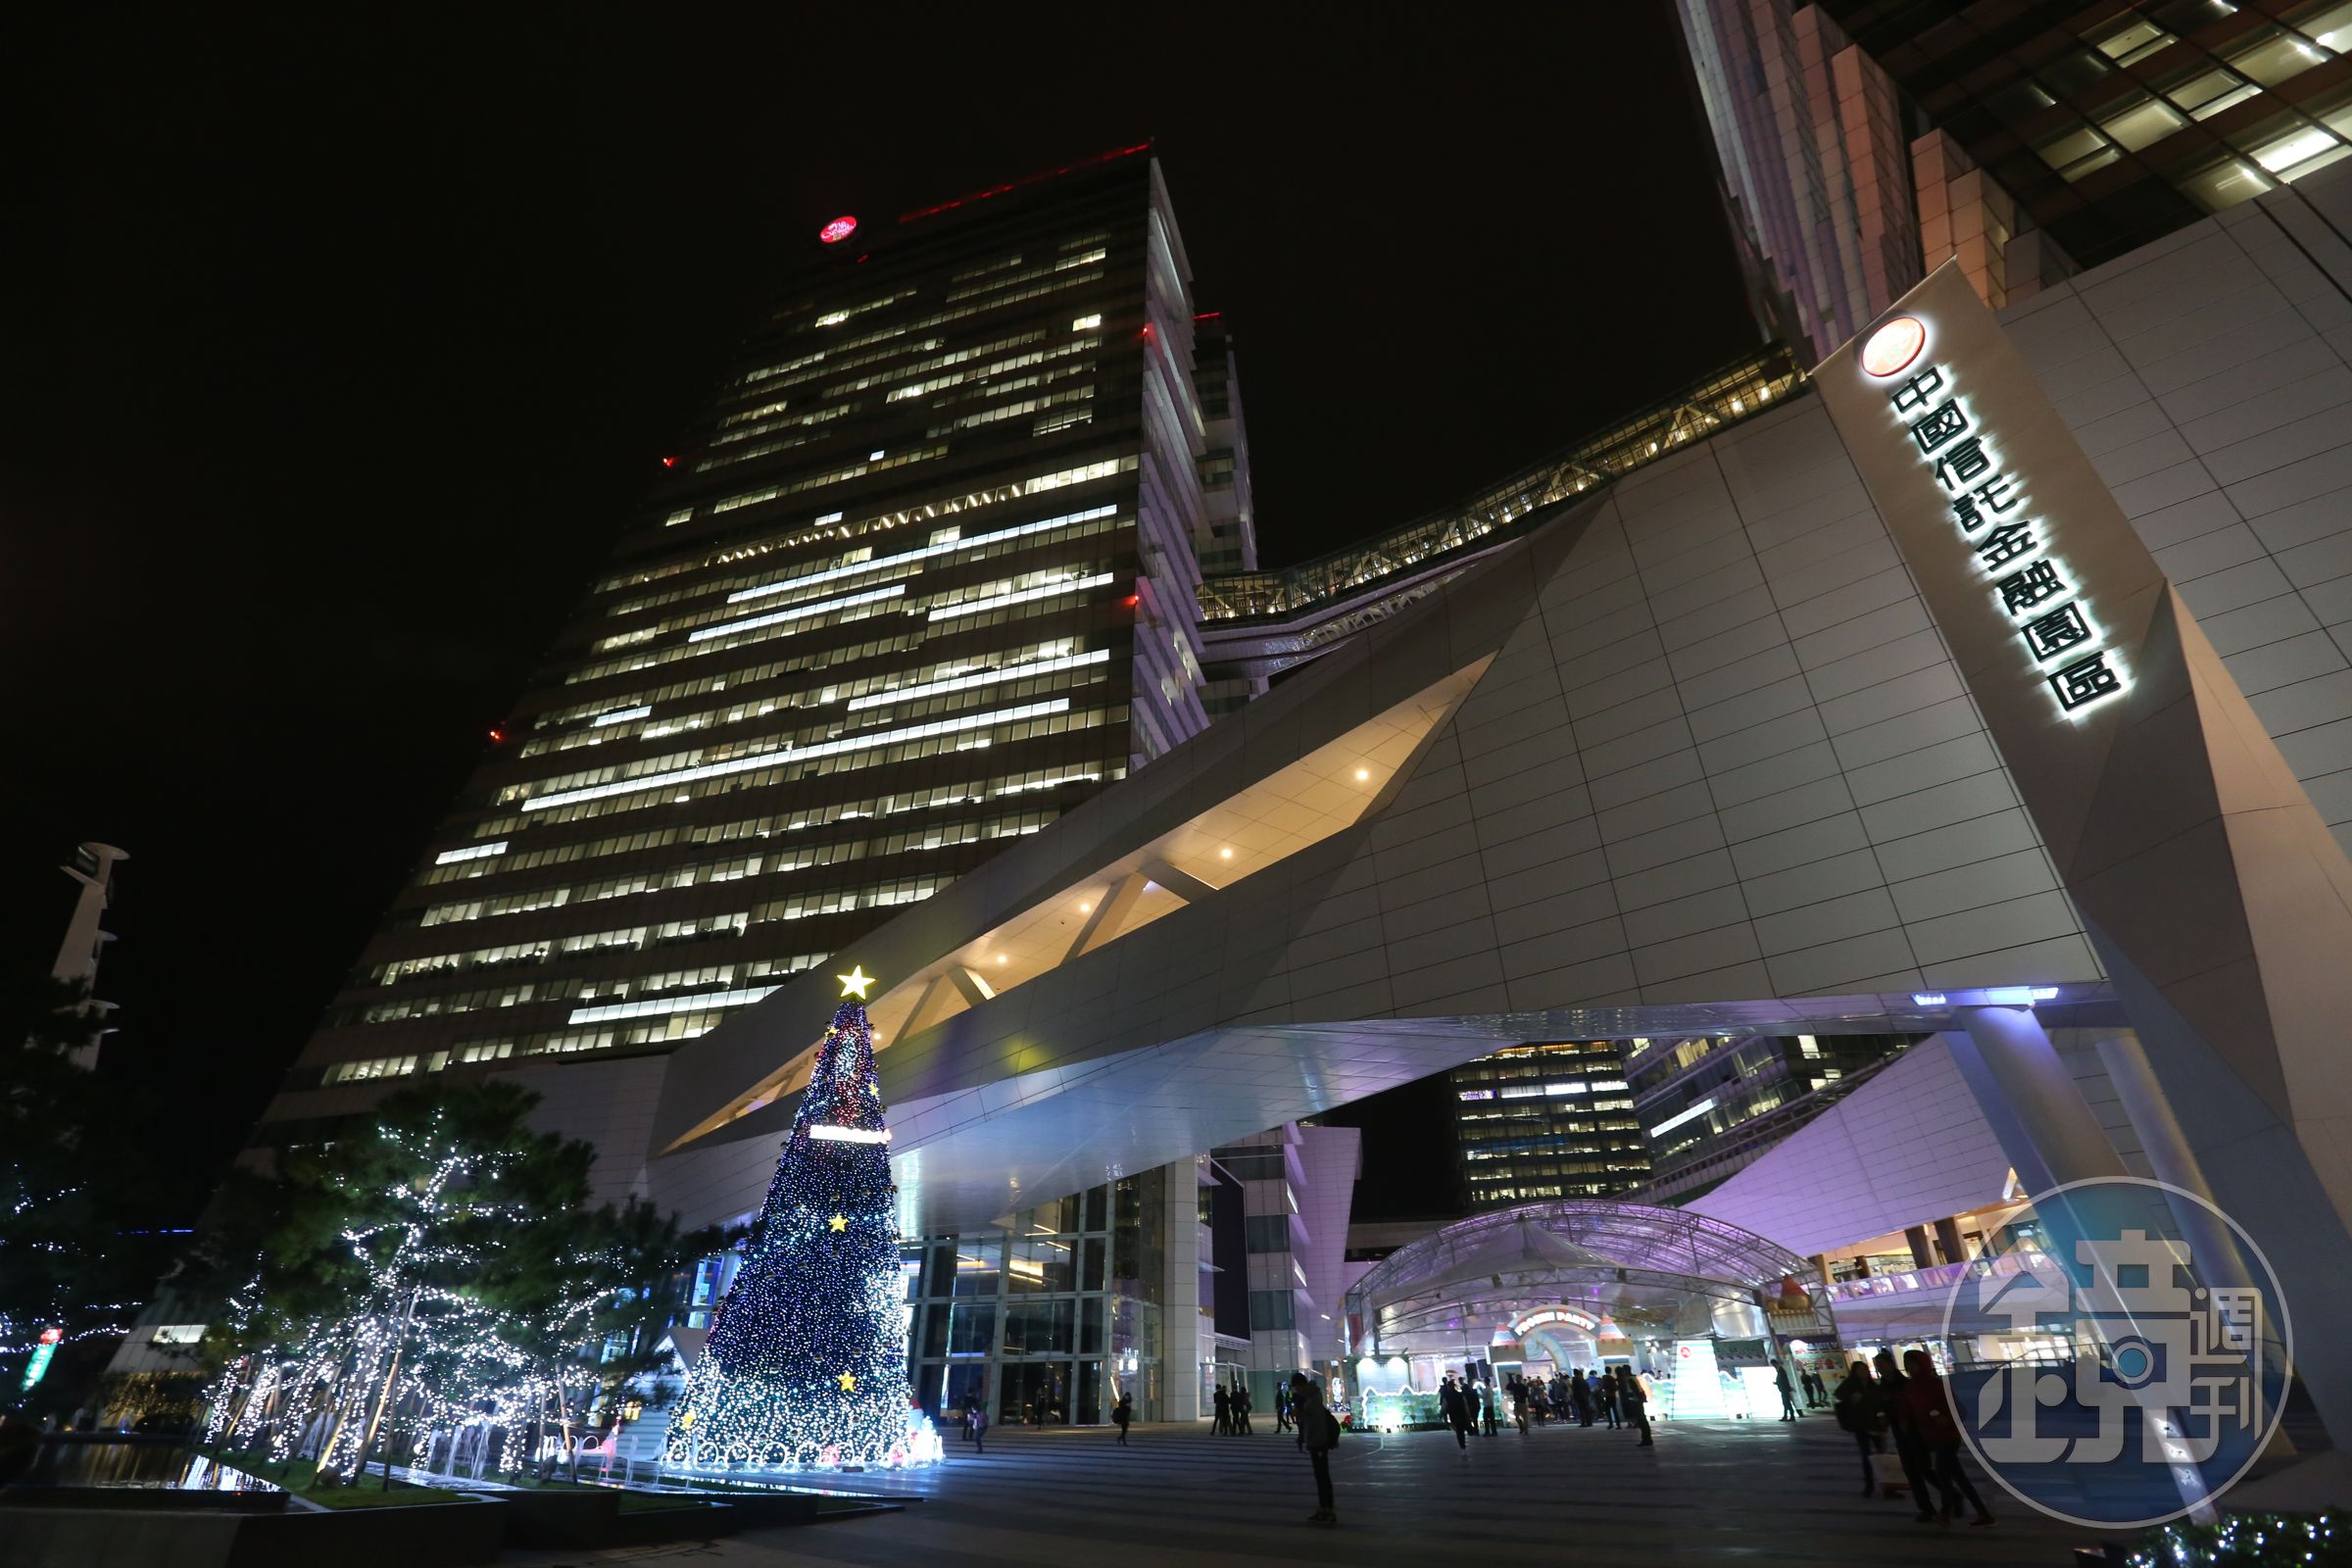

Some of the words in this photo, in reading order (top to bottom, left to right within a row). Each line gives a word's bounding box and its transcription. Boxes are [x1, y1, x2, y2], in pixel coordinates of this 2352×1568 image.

[1890, 366, 2122, 713] 中國信託金融園區
[1556, 1311, 1595, 1331] PARTY
